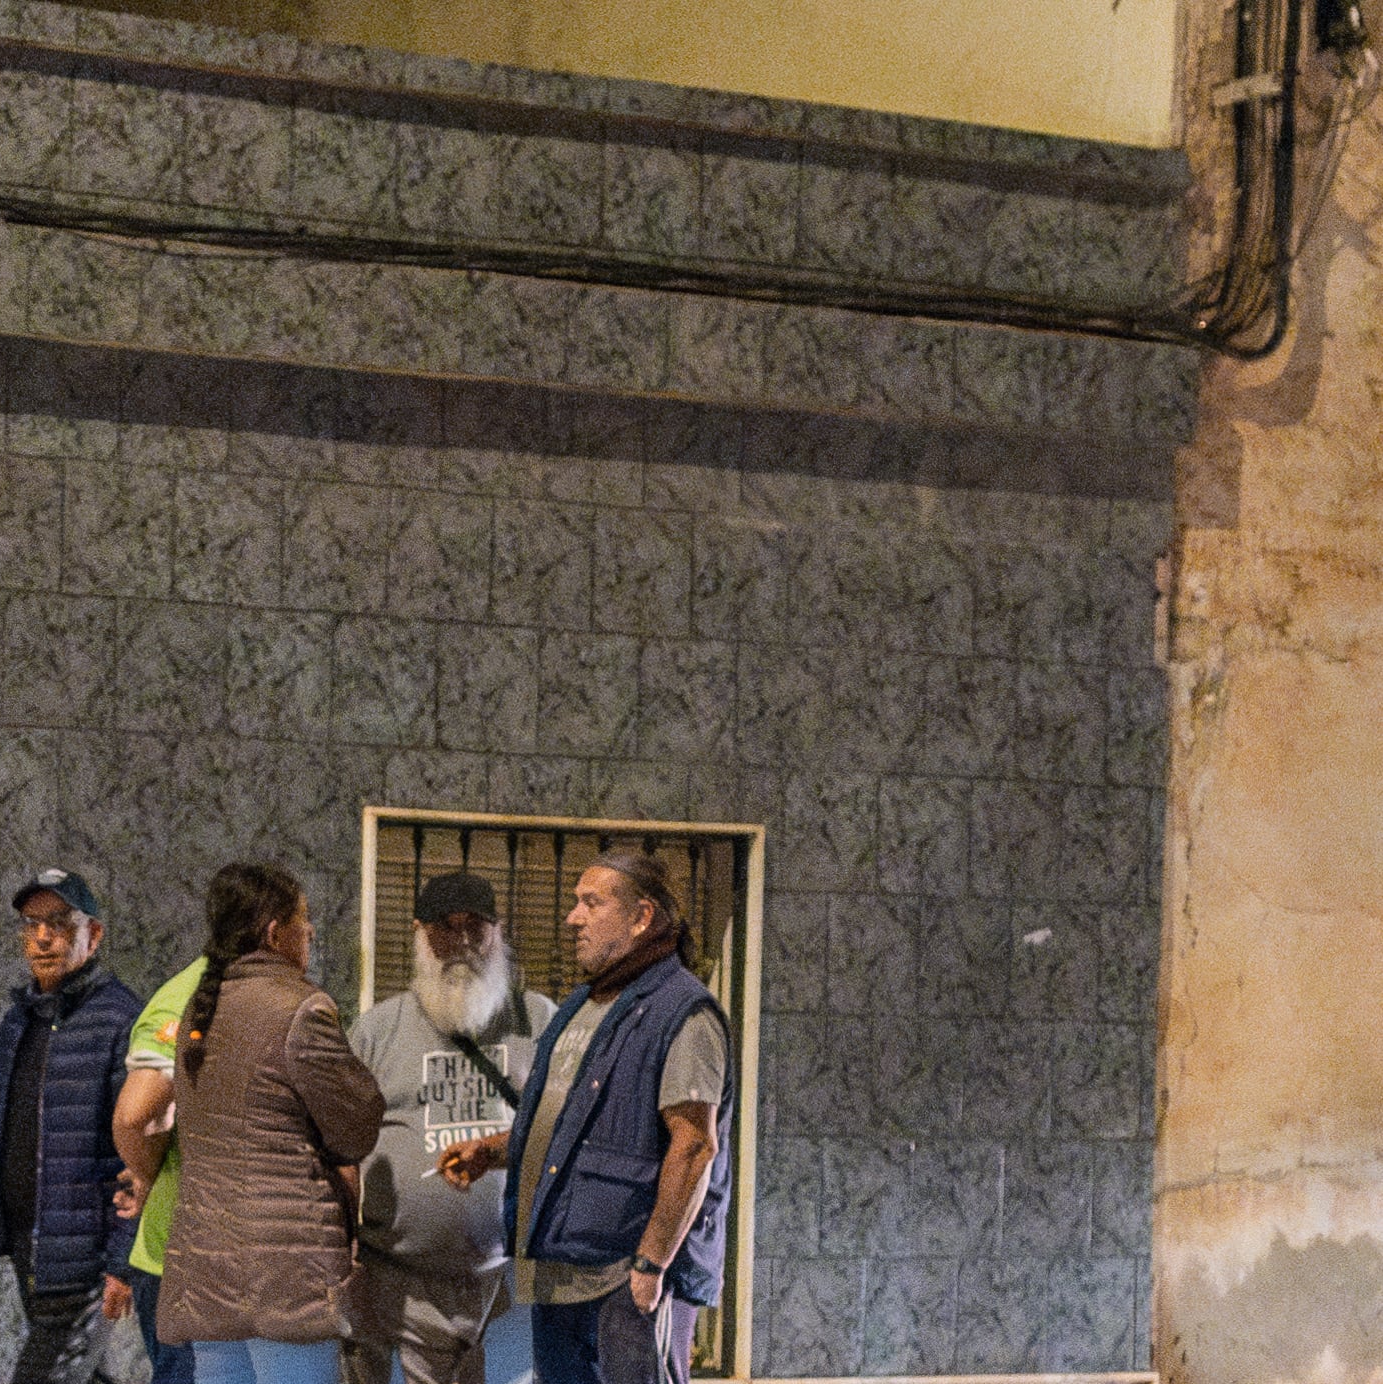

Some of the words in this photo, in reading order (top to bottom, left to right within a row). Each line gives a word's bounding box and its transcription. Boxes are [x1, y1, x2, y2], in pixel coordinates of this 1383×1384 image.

[416, 1076, 510, 1105] OUTSID
[446, 1100, 487, 1123] THE
[424, 1126, 512, 1154] SQUA
